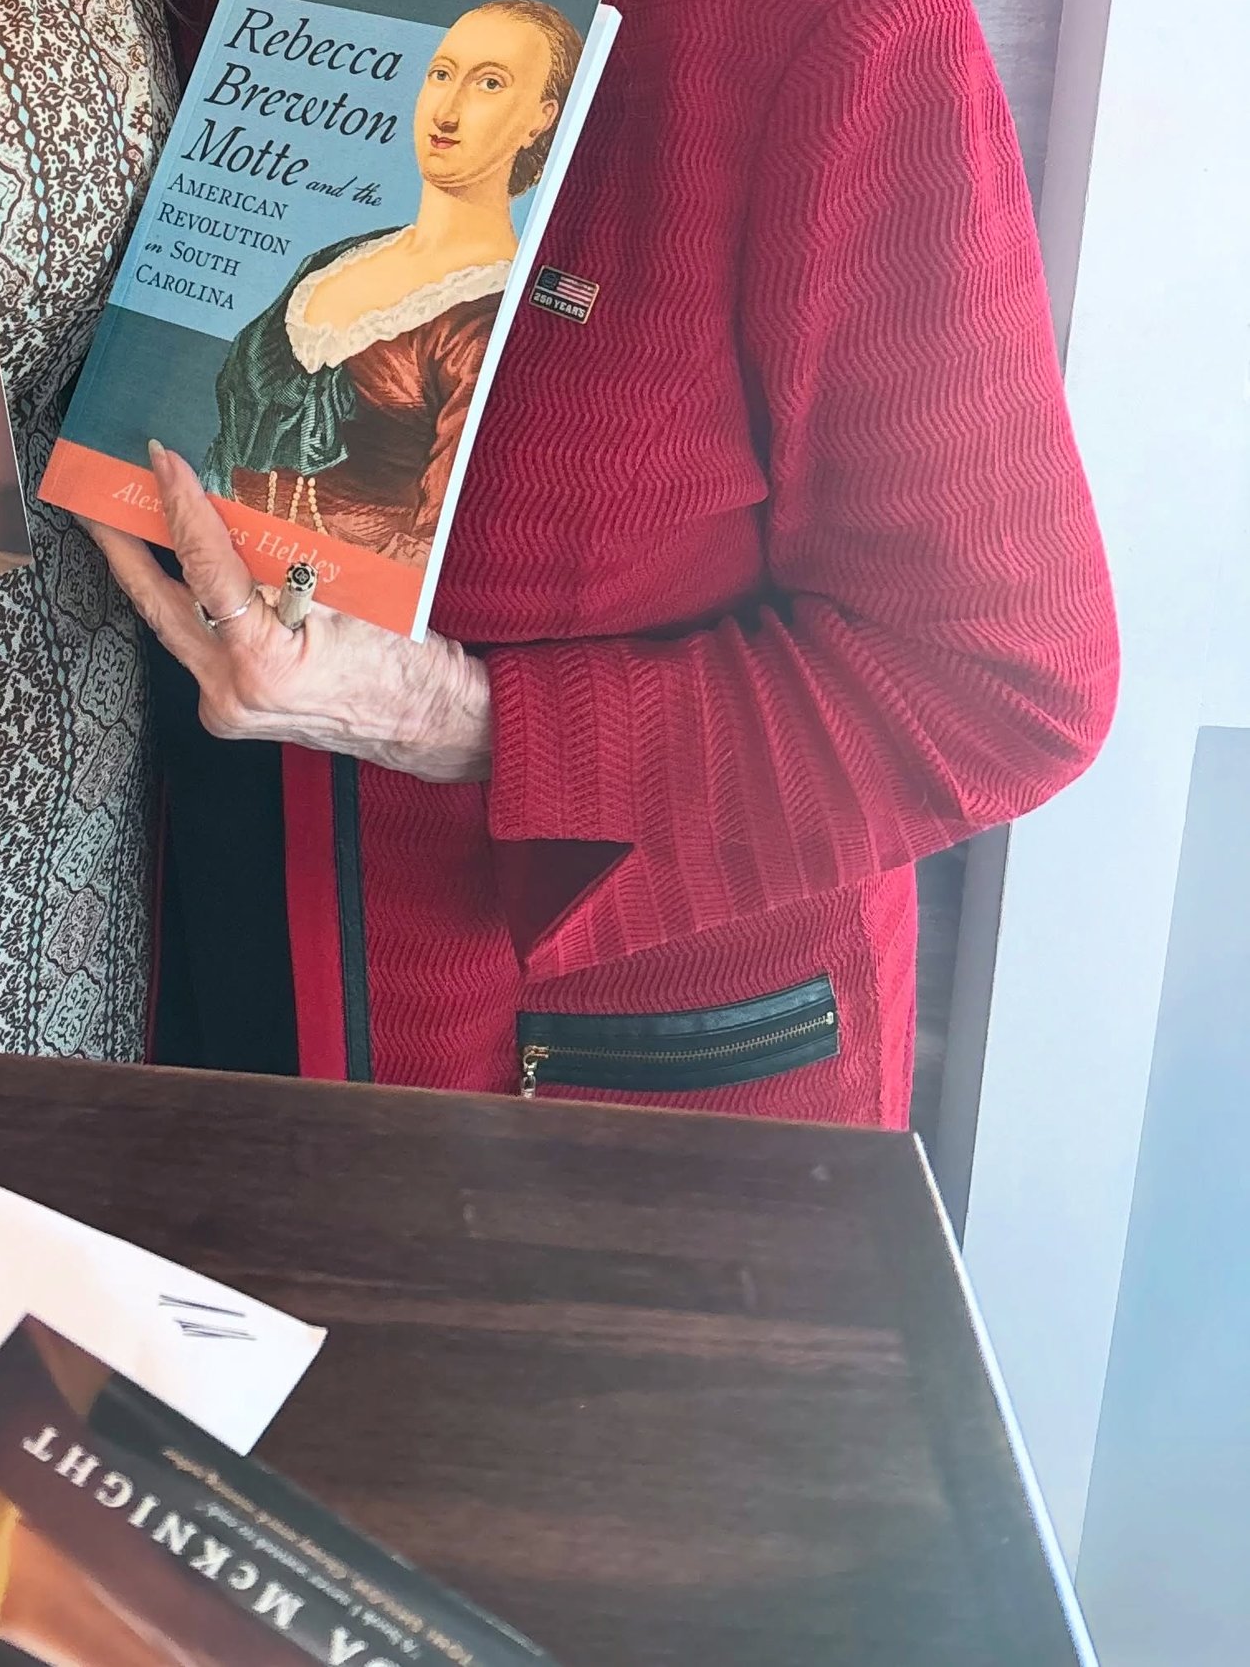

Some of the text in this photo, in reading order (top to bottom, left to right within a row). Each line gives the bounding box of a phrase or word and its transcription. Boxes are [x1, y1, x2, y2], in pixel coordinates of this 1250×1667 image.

[223, 7, 403, 82] Rebecca
[203, 62, 399, 145] Brewton
[181, 118, 383, 207] Motte and the
[157, 201, 292, 256] REVOLUTION
[167, 172, 290, 221] AMERICAN
[135, 264, 235, 311] CAROLINA
[145, 236, 242, 277] in SOUTH
[533, 292, 586, 318] 250 YEARS
[112, 481, 165, 517] Alex
[255, 531, 341, 584] Helsley
[21, 1426, 307, 1632] McKNIGHT
